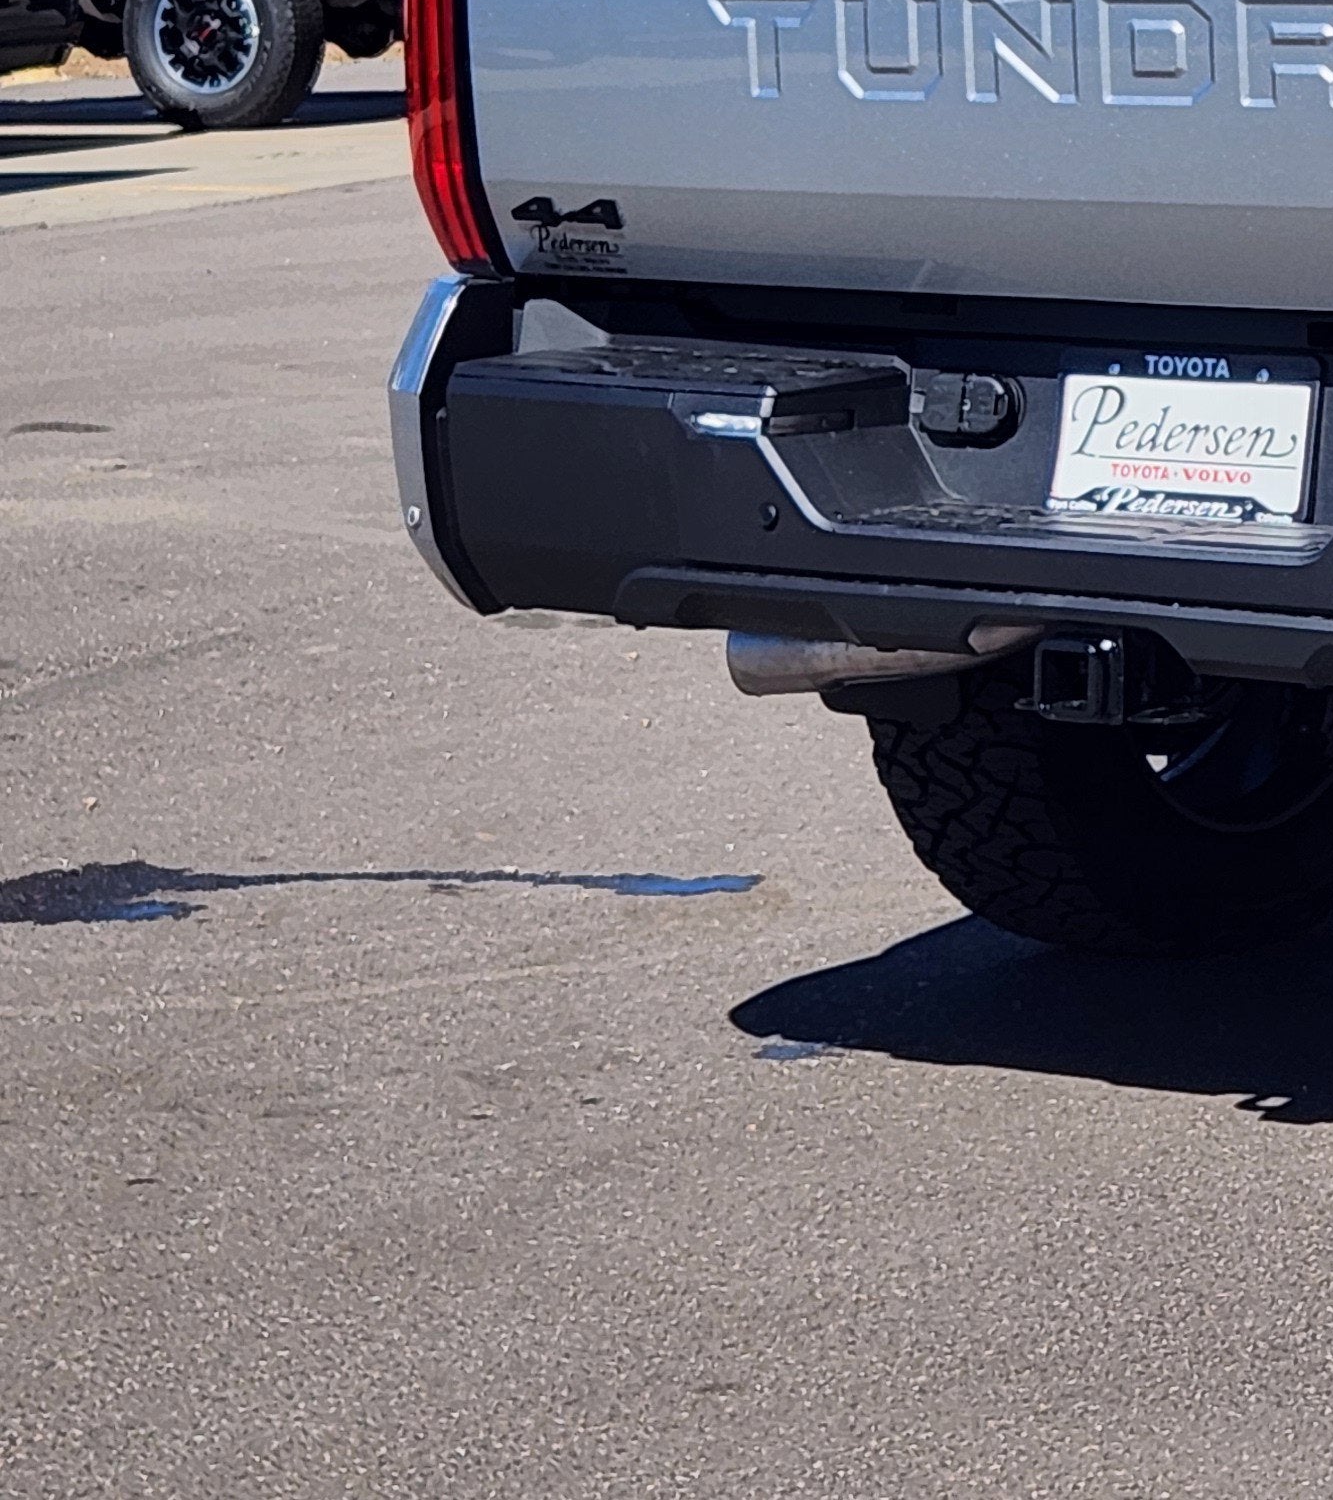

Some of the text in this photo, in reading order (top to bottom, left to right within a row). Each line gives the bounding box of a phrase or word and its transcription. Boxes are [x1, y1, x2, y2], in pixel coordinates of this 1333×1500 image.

[1144, 354, 1230, 379] TOYOTA
[1070, 384, 1298, 459] Pedersen
[1111, 463, 1252, 485] TOYOTA VOLVO
[1101, 485, 1243, 520] Pedersen
